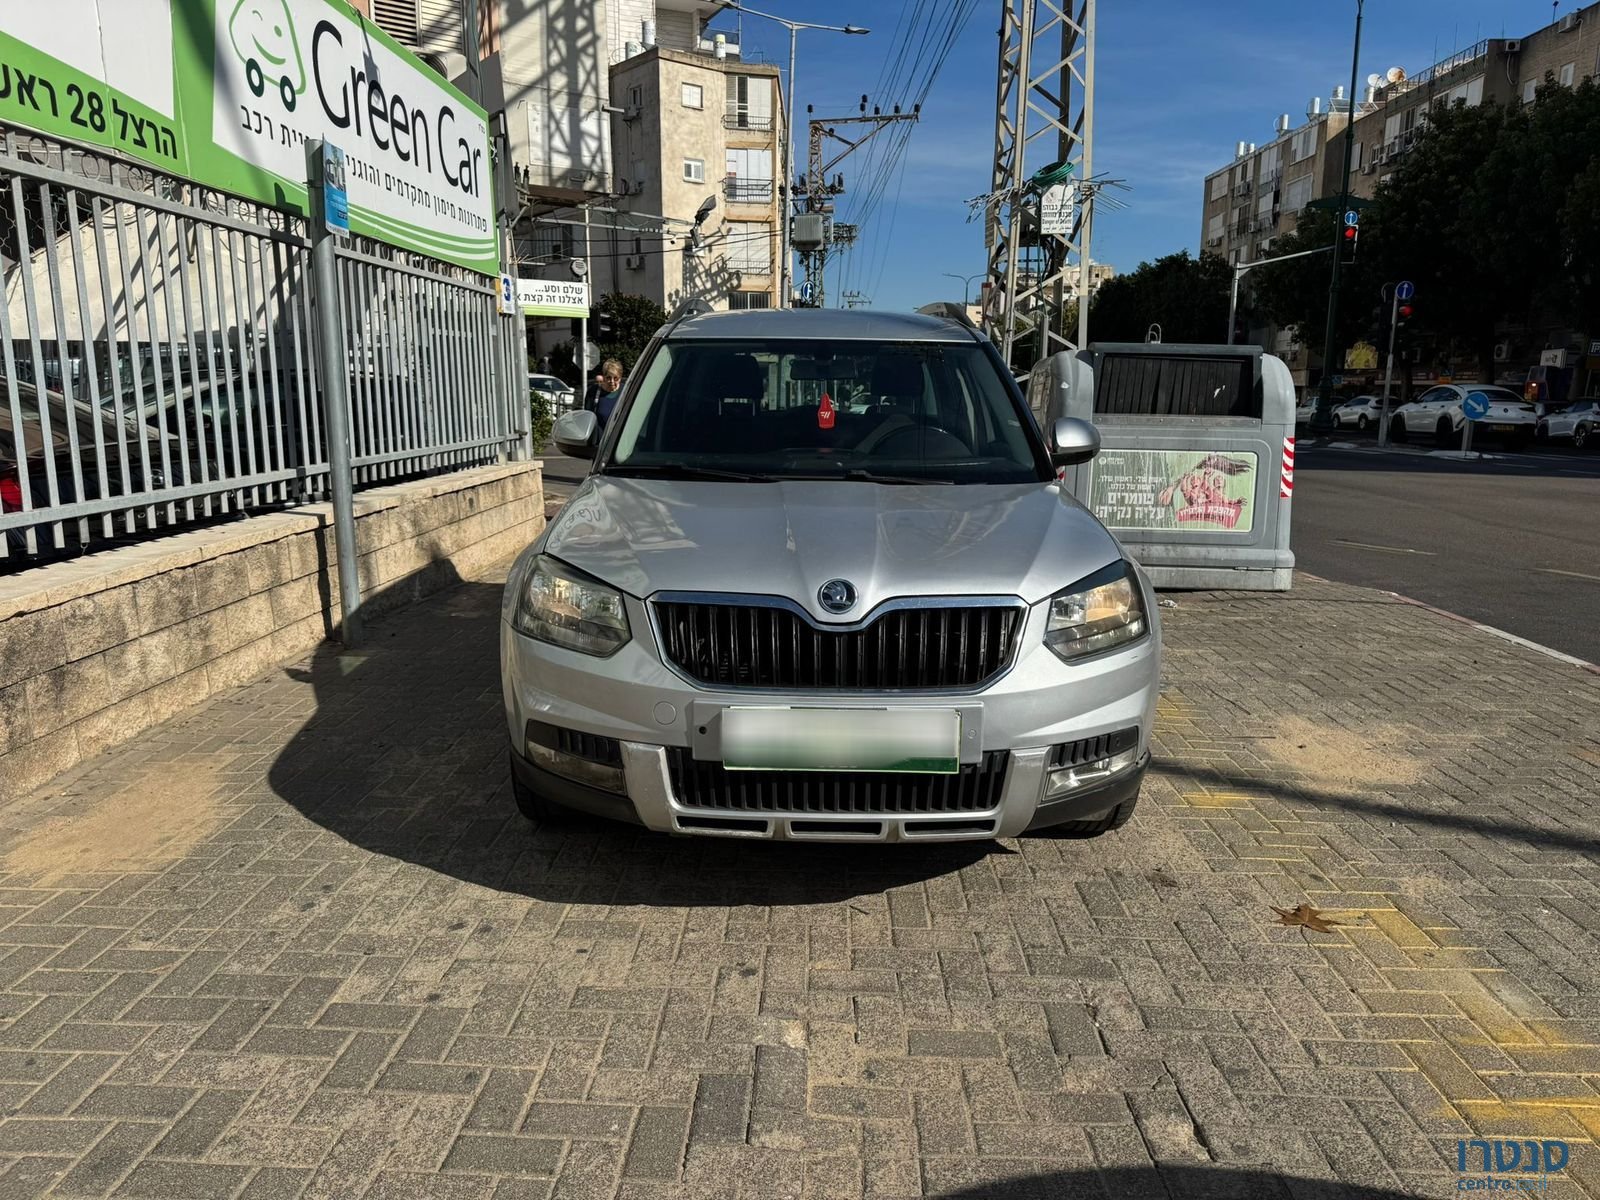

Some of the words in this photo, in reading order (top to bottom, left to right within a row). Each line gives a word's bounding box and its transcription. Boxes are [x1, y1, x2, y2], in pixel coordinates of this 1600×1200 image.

[66, 83, 106, 133] 28
[312, 20, 432, 173] Green
[437, 105, 482, 198] Car
[112, 98, 178, 160] הרצל
[240, 105, 274, 141] רכב
[385, 173, 431, 208] מתקדמים
[433, 195, 456, 219] מימון
[458, 207, 487, 233] פתרונות
[523, 293, 543, 304] קצת
[545, 294, 556, 303] זה
[559, 293, 583, 304] אצלנו
[563, 284, 583, 294] שלם
[1108, 492, 1154, 505] שומרים
[1135, 504, 1165, 519] עליה
